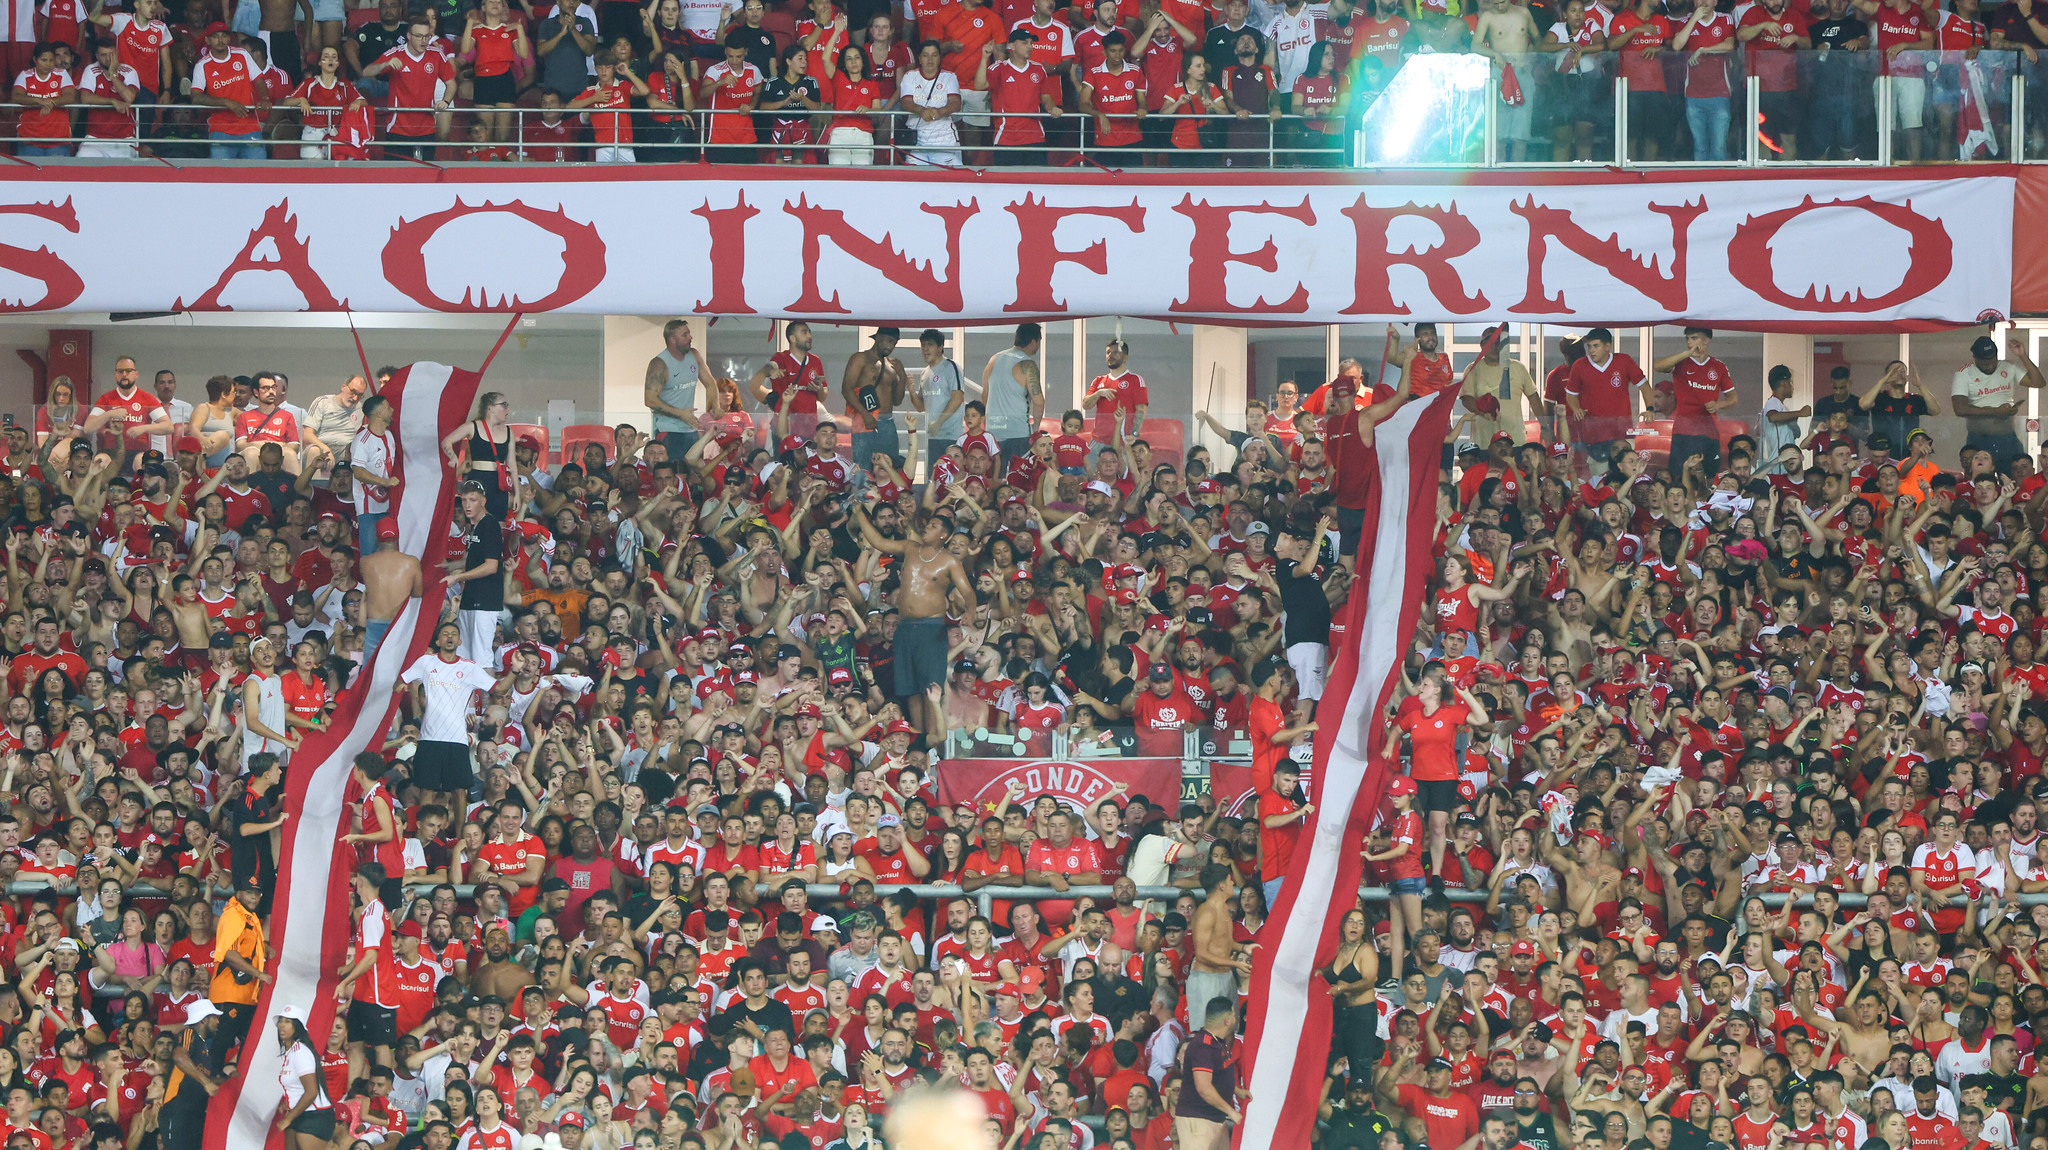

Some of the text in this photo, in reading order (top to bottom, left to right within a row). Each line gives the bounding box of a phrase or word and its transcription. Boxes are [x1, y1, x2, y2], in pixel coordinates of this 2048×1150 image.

[1882, 22, 1917, 35] Banrisul
[221, 74, 245, 86] banrisul
[692, 188, 1953, 314] INFERNO
[1692, 381, 1717, 391] Banrisul
[1984, 384, 2011, 396] Banrisul
[1004, 766, 1104, 801] BONDE
